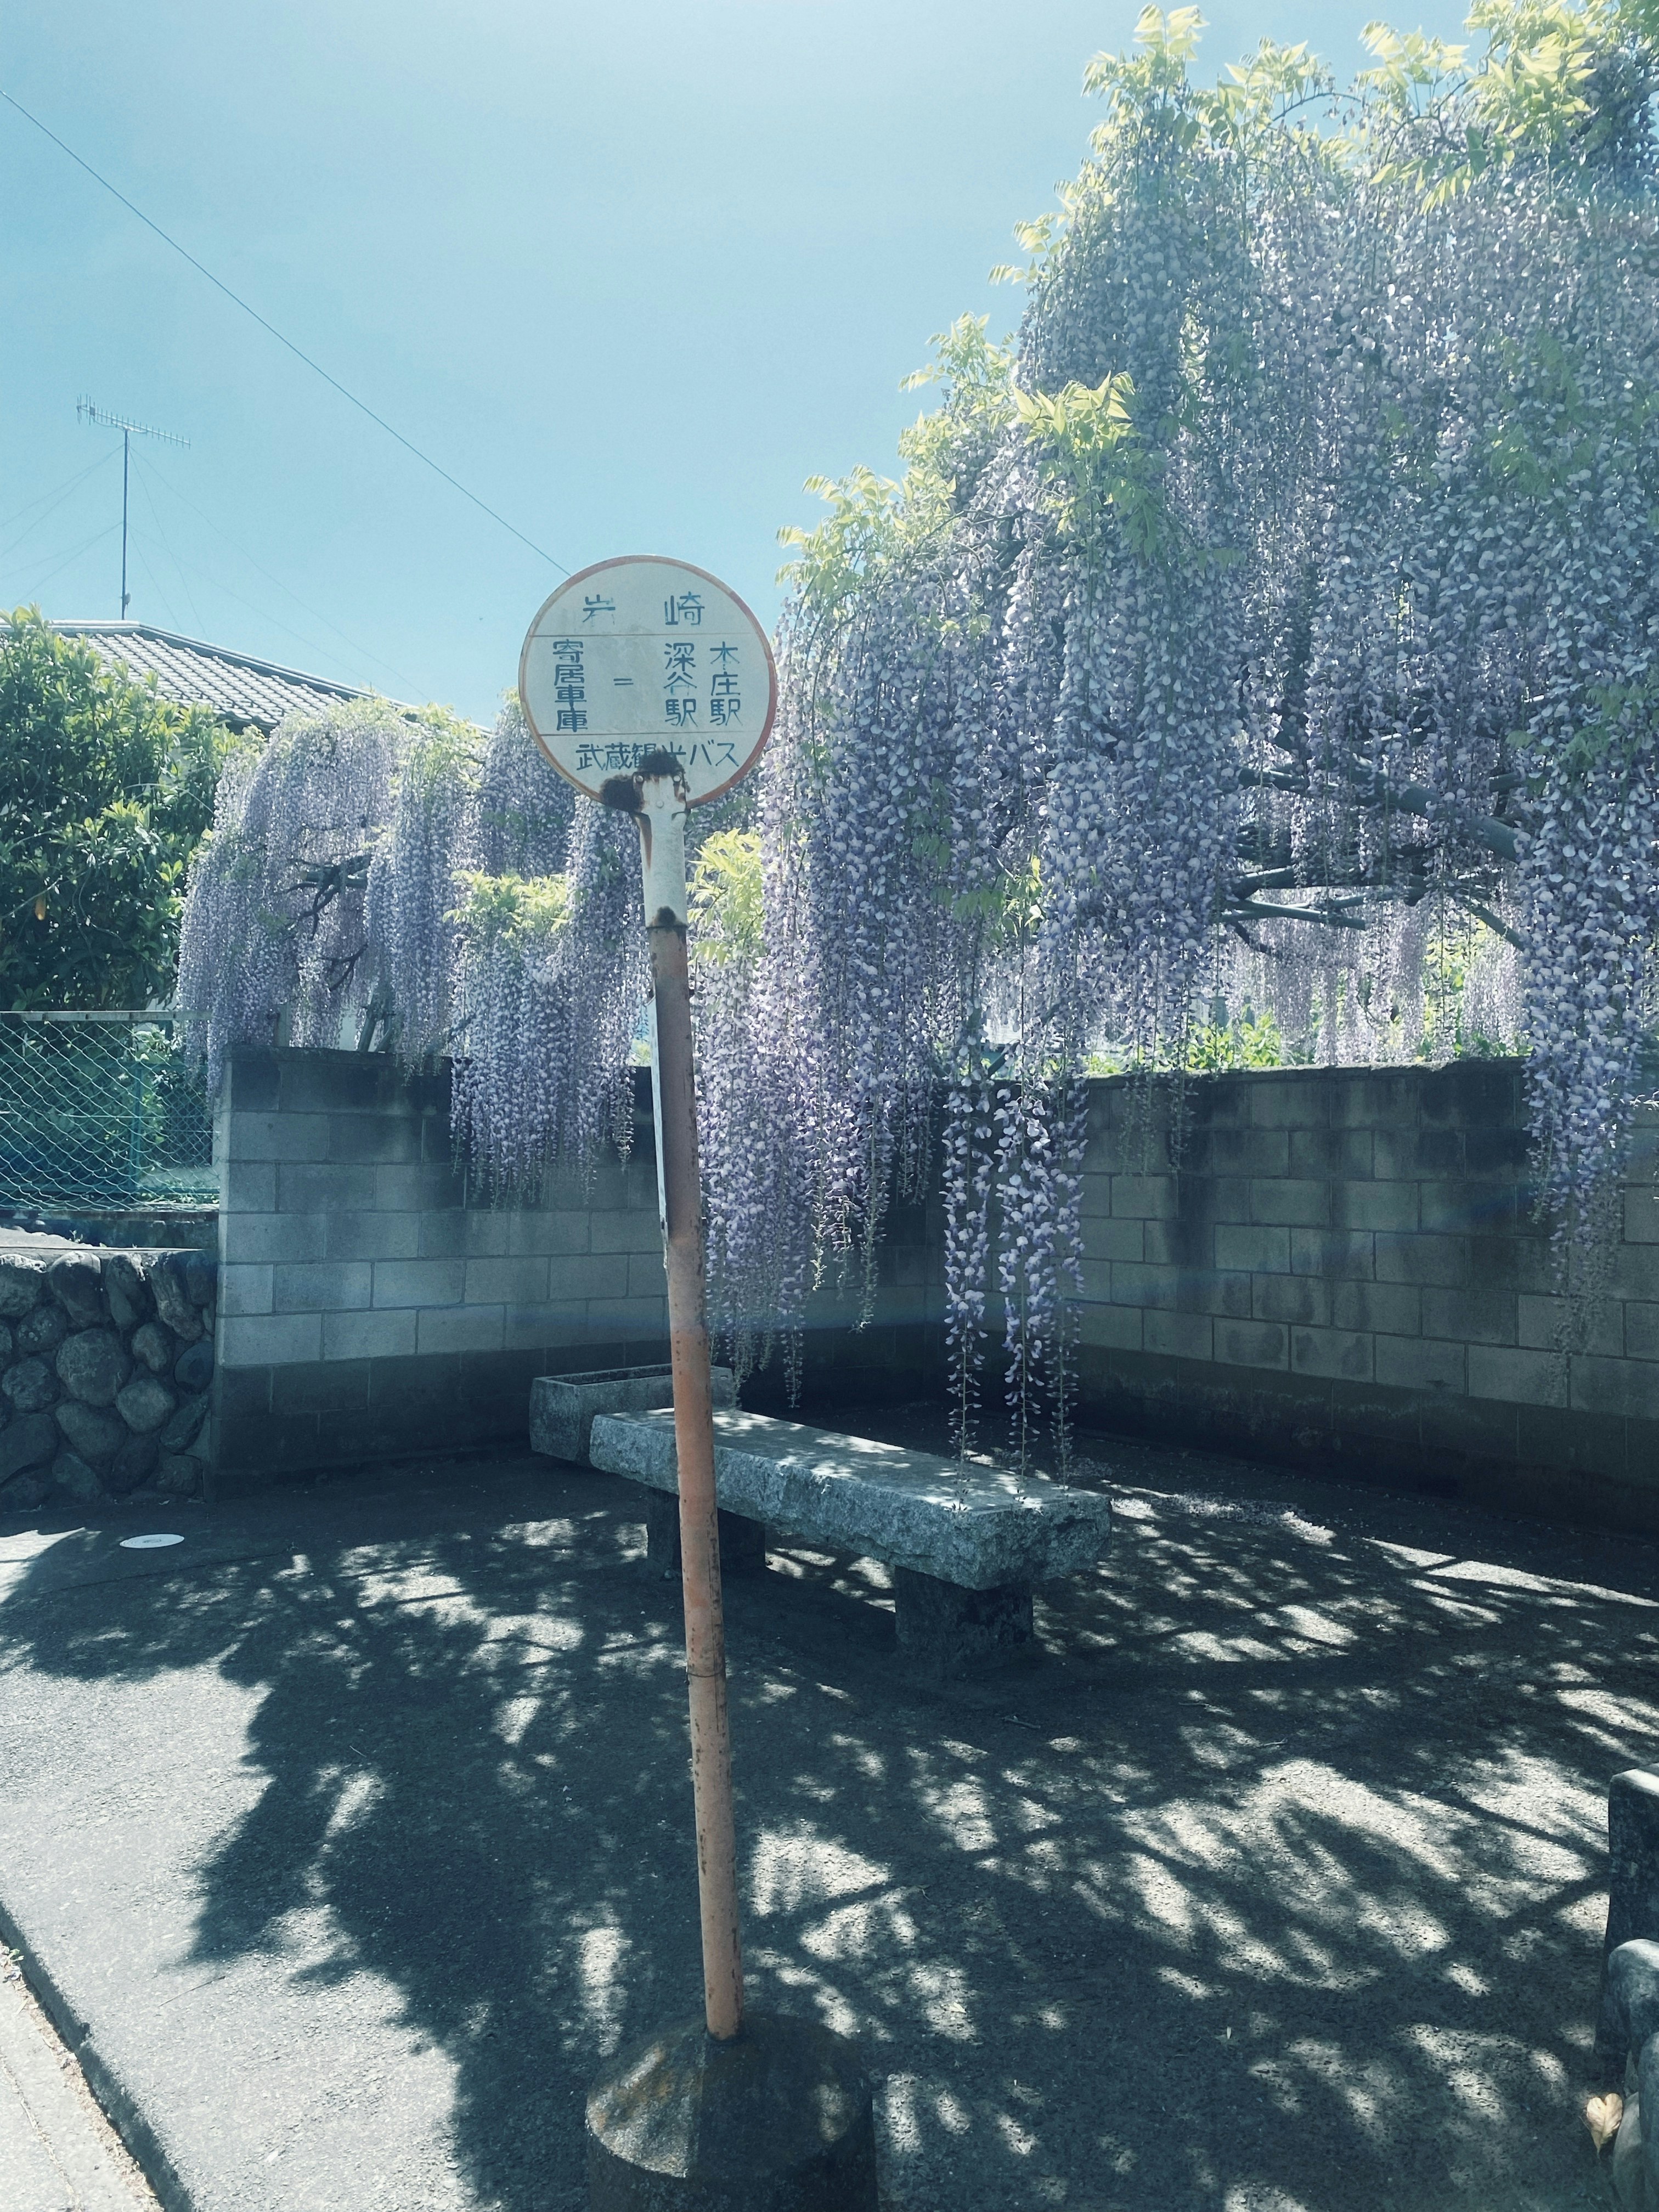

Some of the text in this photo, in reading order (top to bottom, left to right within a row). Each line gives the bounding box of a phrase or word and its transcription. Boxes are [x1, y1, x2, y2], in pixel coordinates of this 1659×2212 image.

[552, 639, 588, 732] 寄居車庫
[663, 642, 698, 727] 深谷駅
